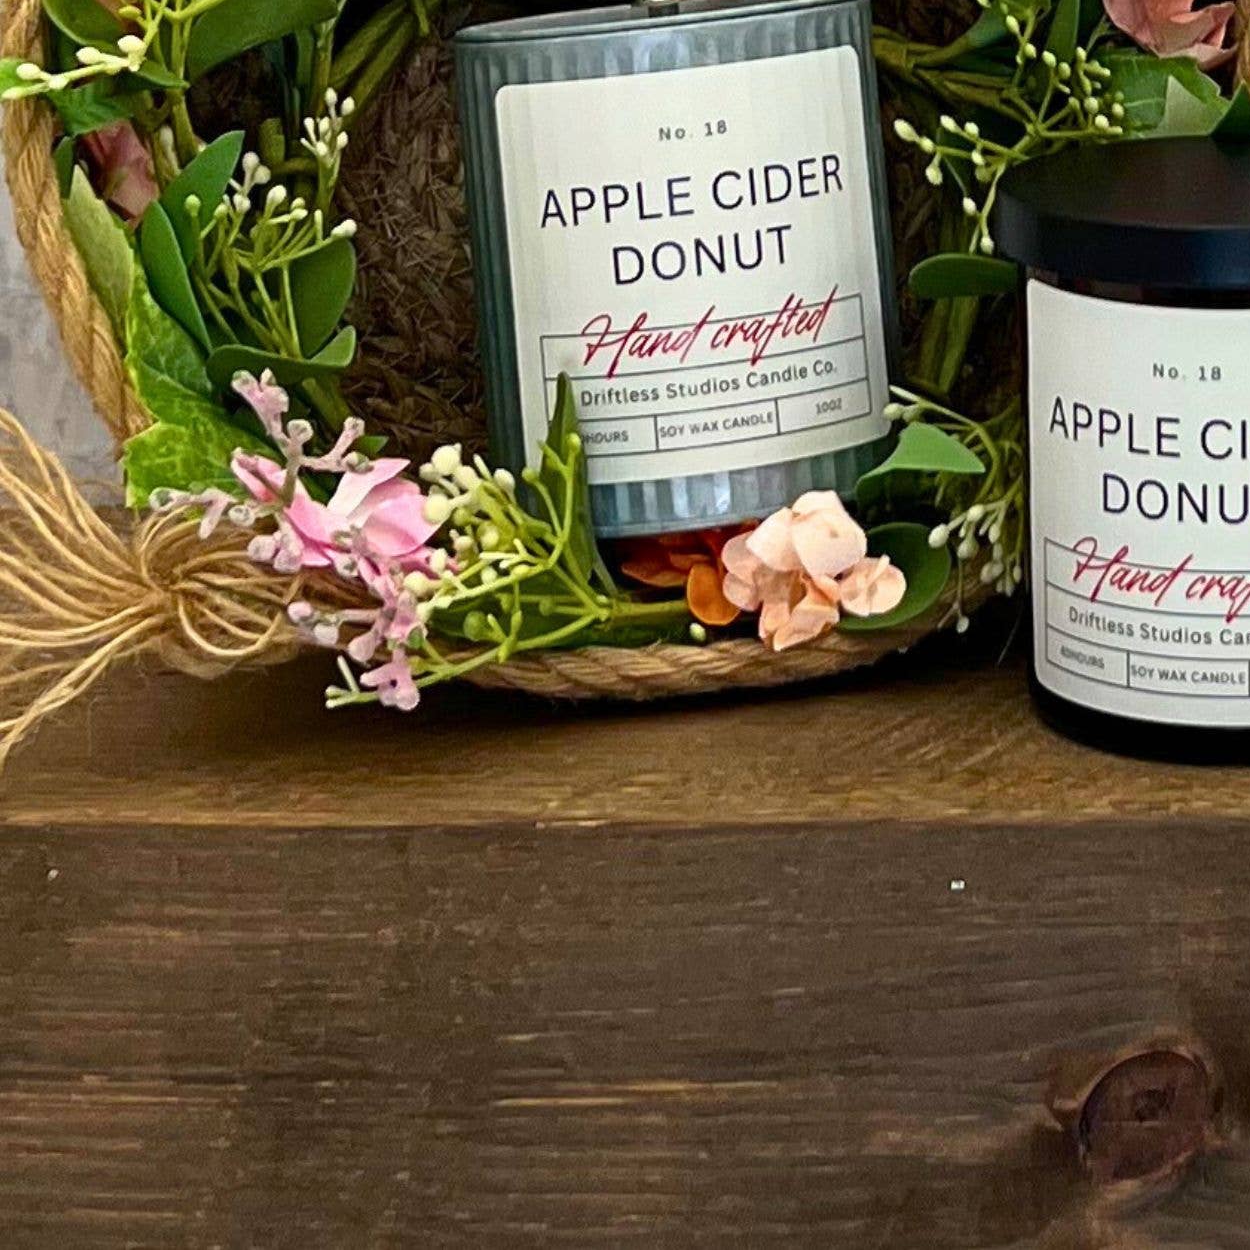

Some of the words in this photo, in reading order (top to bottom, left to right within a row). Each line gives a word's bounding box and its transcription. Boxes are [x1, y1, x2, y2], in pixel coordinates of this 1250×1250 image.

[658, 125, 693, 142] No.
[704, 120, 728, 137] 18
[541, 176, 695, 228] APPLE
[712, 154, 844, 210] CIDER
[612, 224, 793, 285] DONUT
[581, 305, 716, 379] Hand
[710, 284, 840, 366] crafted
[581, 383, 660, 407] Driftless
[666, 374, 741, 399] Studios
[746, 361, 809, 388] Candle
[813, 358, 838, 377] Co.
[1152, 363, 1187, 380] No.
[1198, 366, 1223, 381] 18
[659, 425, 685, 438] SOY
[689, 421, 719, 434] WAX
[722, 411, 774, 430] CANDLE
[1049, 396, 1181, 458] APPLE
[1071, 536, 1194, 607] Hand
[1068, 605, 1134, 637] Driftless
[1139, 622, 1212, 645] Studios
[1130, 665, 1155, 678] SOY
[1158, 668, 1187, 682] WAX
[1191, 671, 1246, 684] CANDLE
